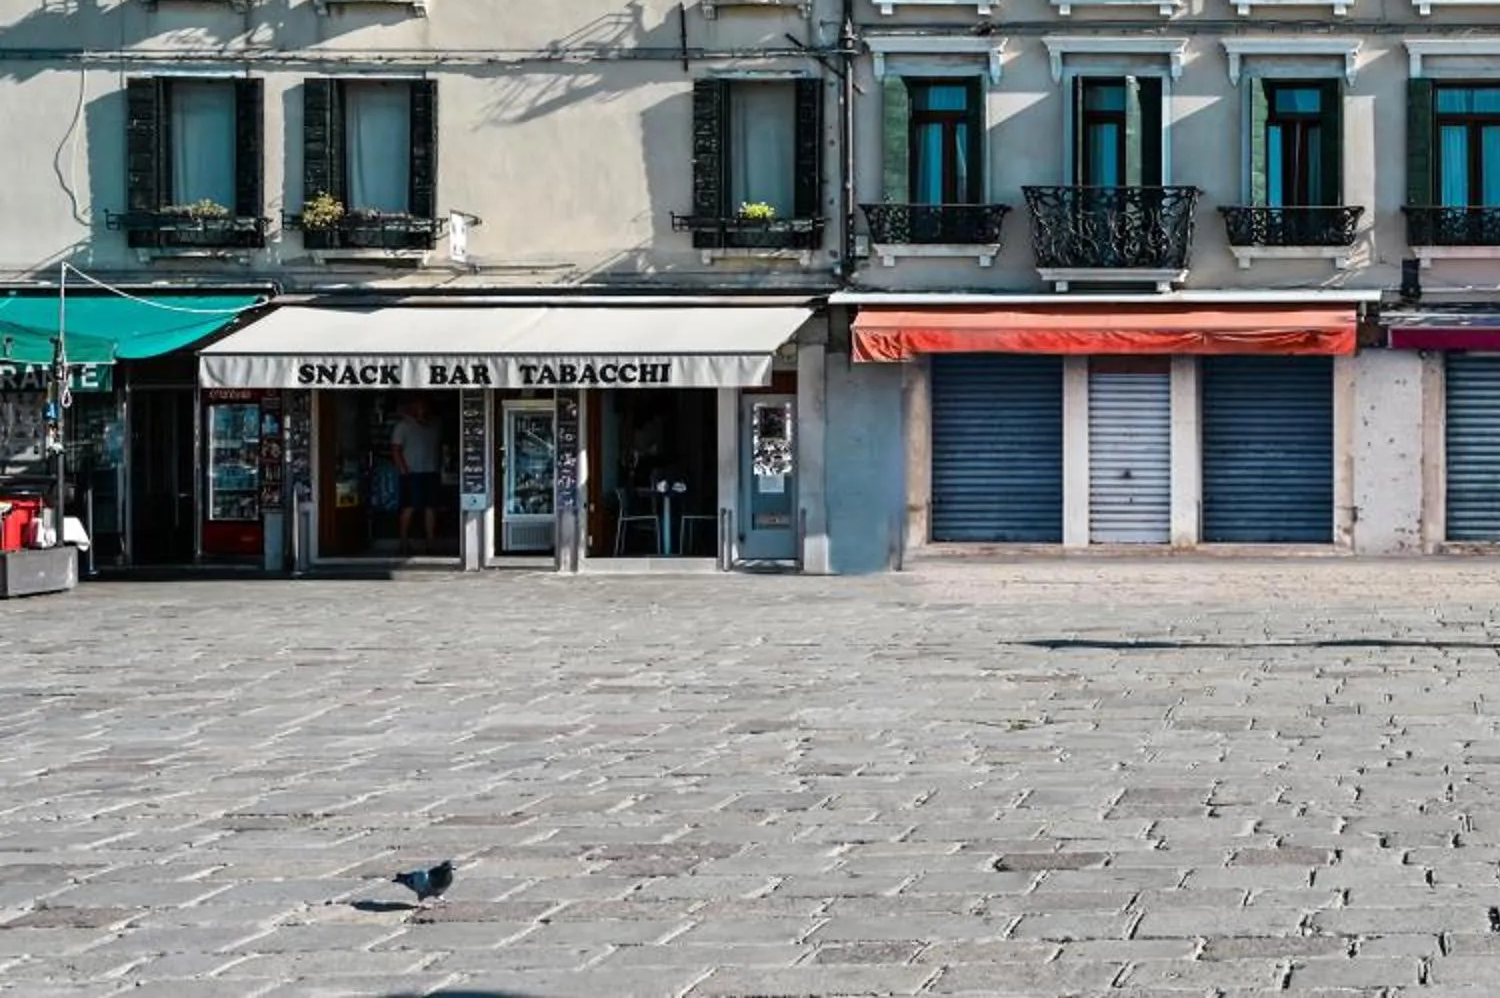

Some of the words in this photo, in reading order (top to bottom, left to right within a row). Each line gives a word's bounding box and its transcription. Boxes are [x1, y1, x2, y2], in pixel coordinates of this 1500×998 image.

[298, 364, 400, 384] SNACK
[429, 364, 492, 384] BAR
[519, 363, 671, 384] TABACCHI
